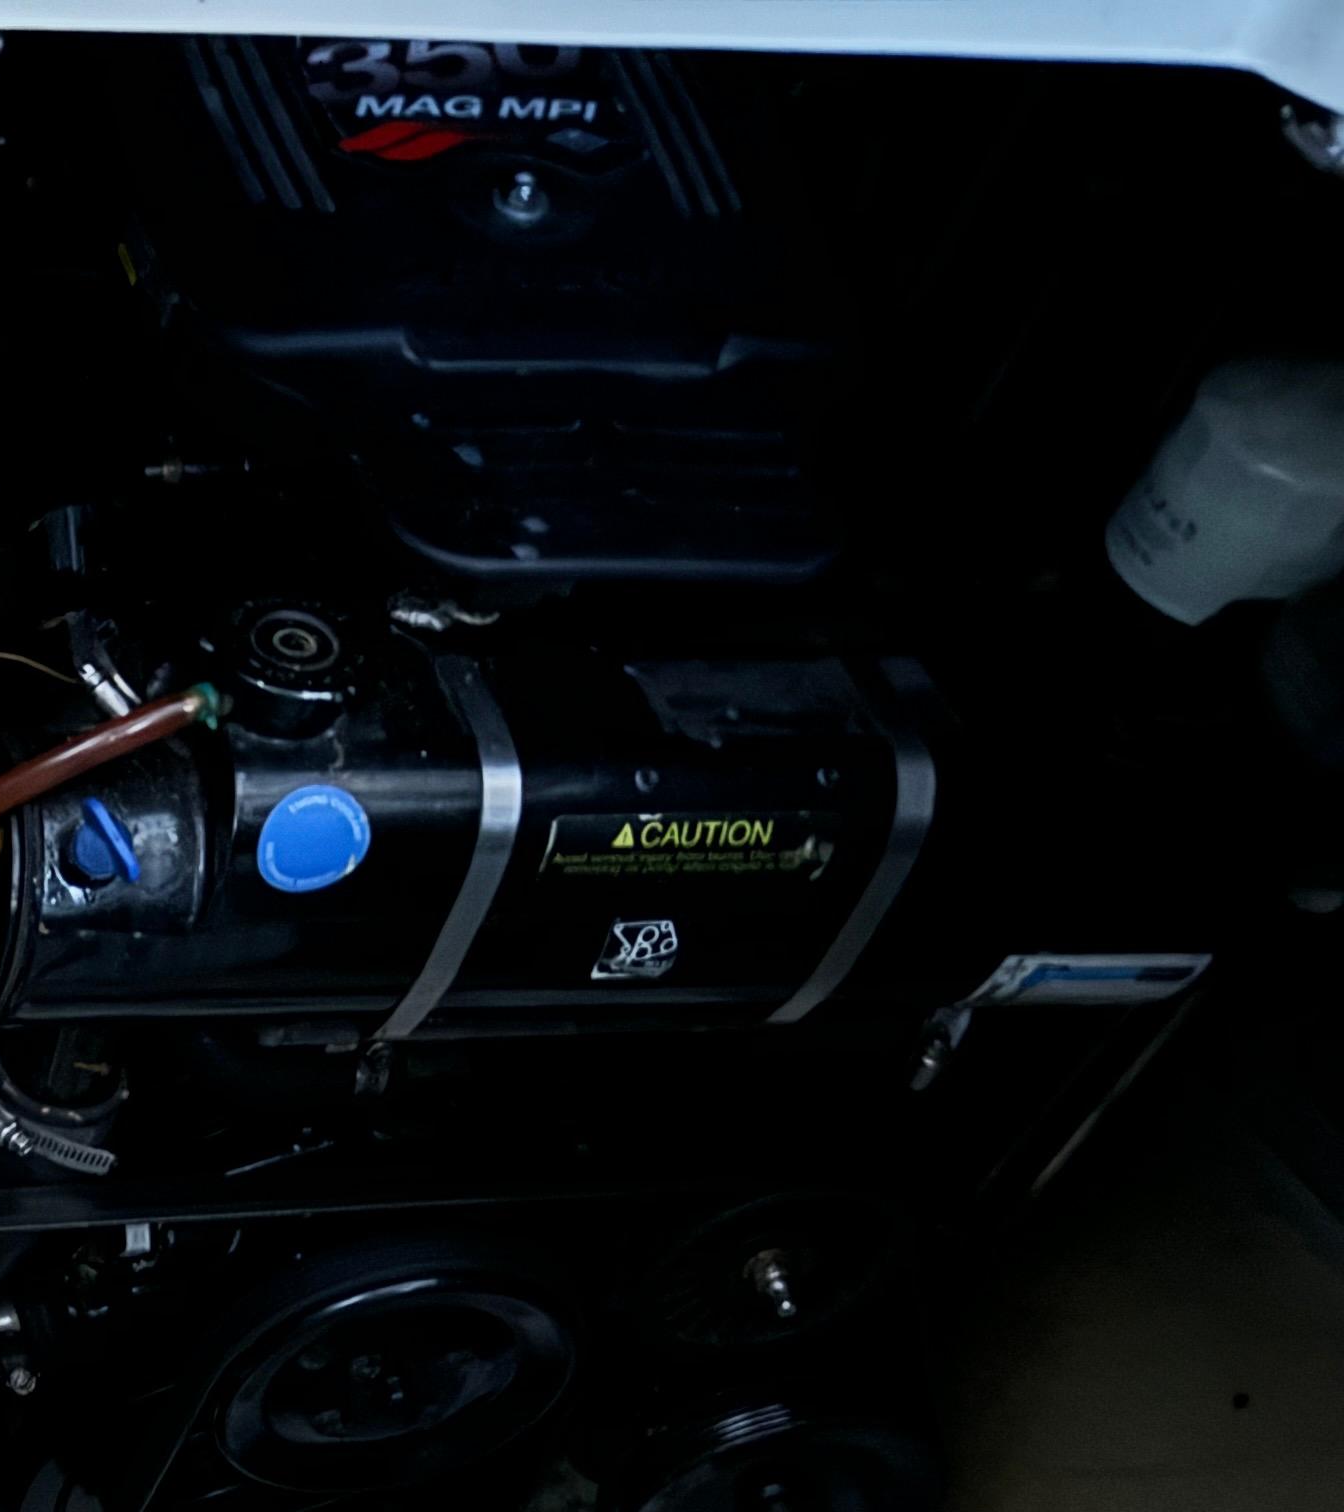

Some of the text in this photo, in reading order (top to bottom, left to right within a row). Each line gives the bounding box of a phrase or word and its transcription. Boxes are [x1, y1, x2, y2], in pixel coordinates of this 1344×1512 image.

[354, 93, 599, 123] MAG MPI
[639, 818, 775, 849] CAUTION
